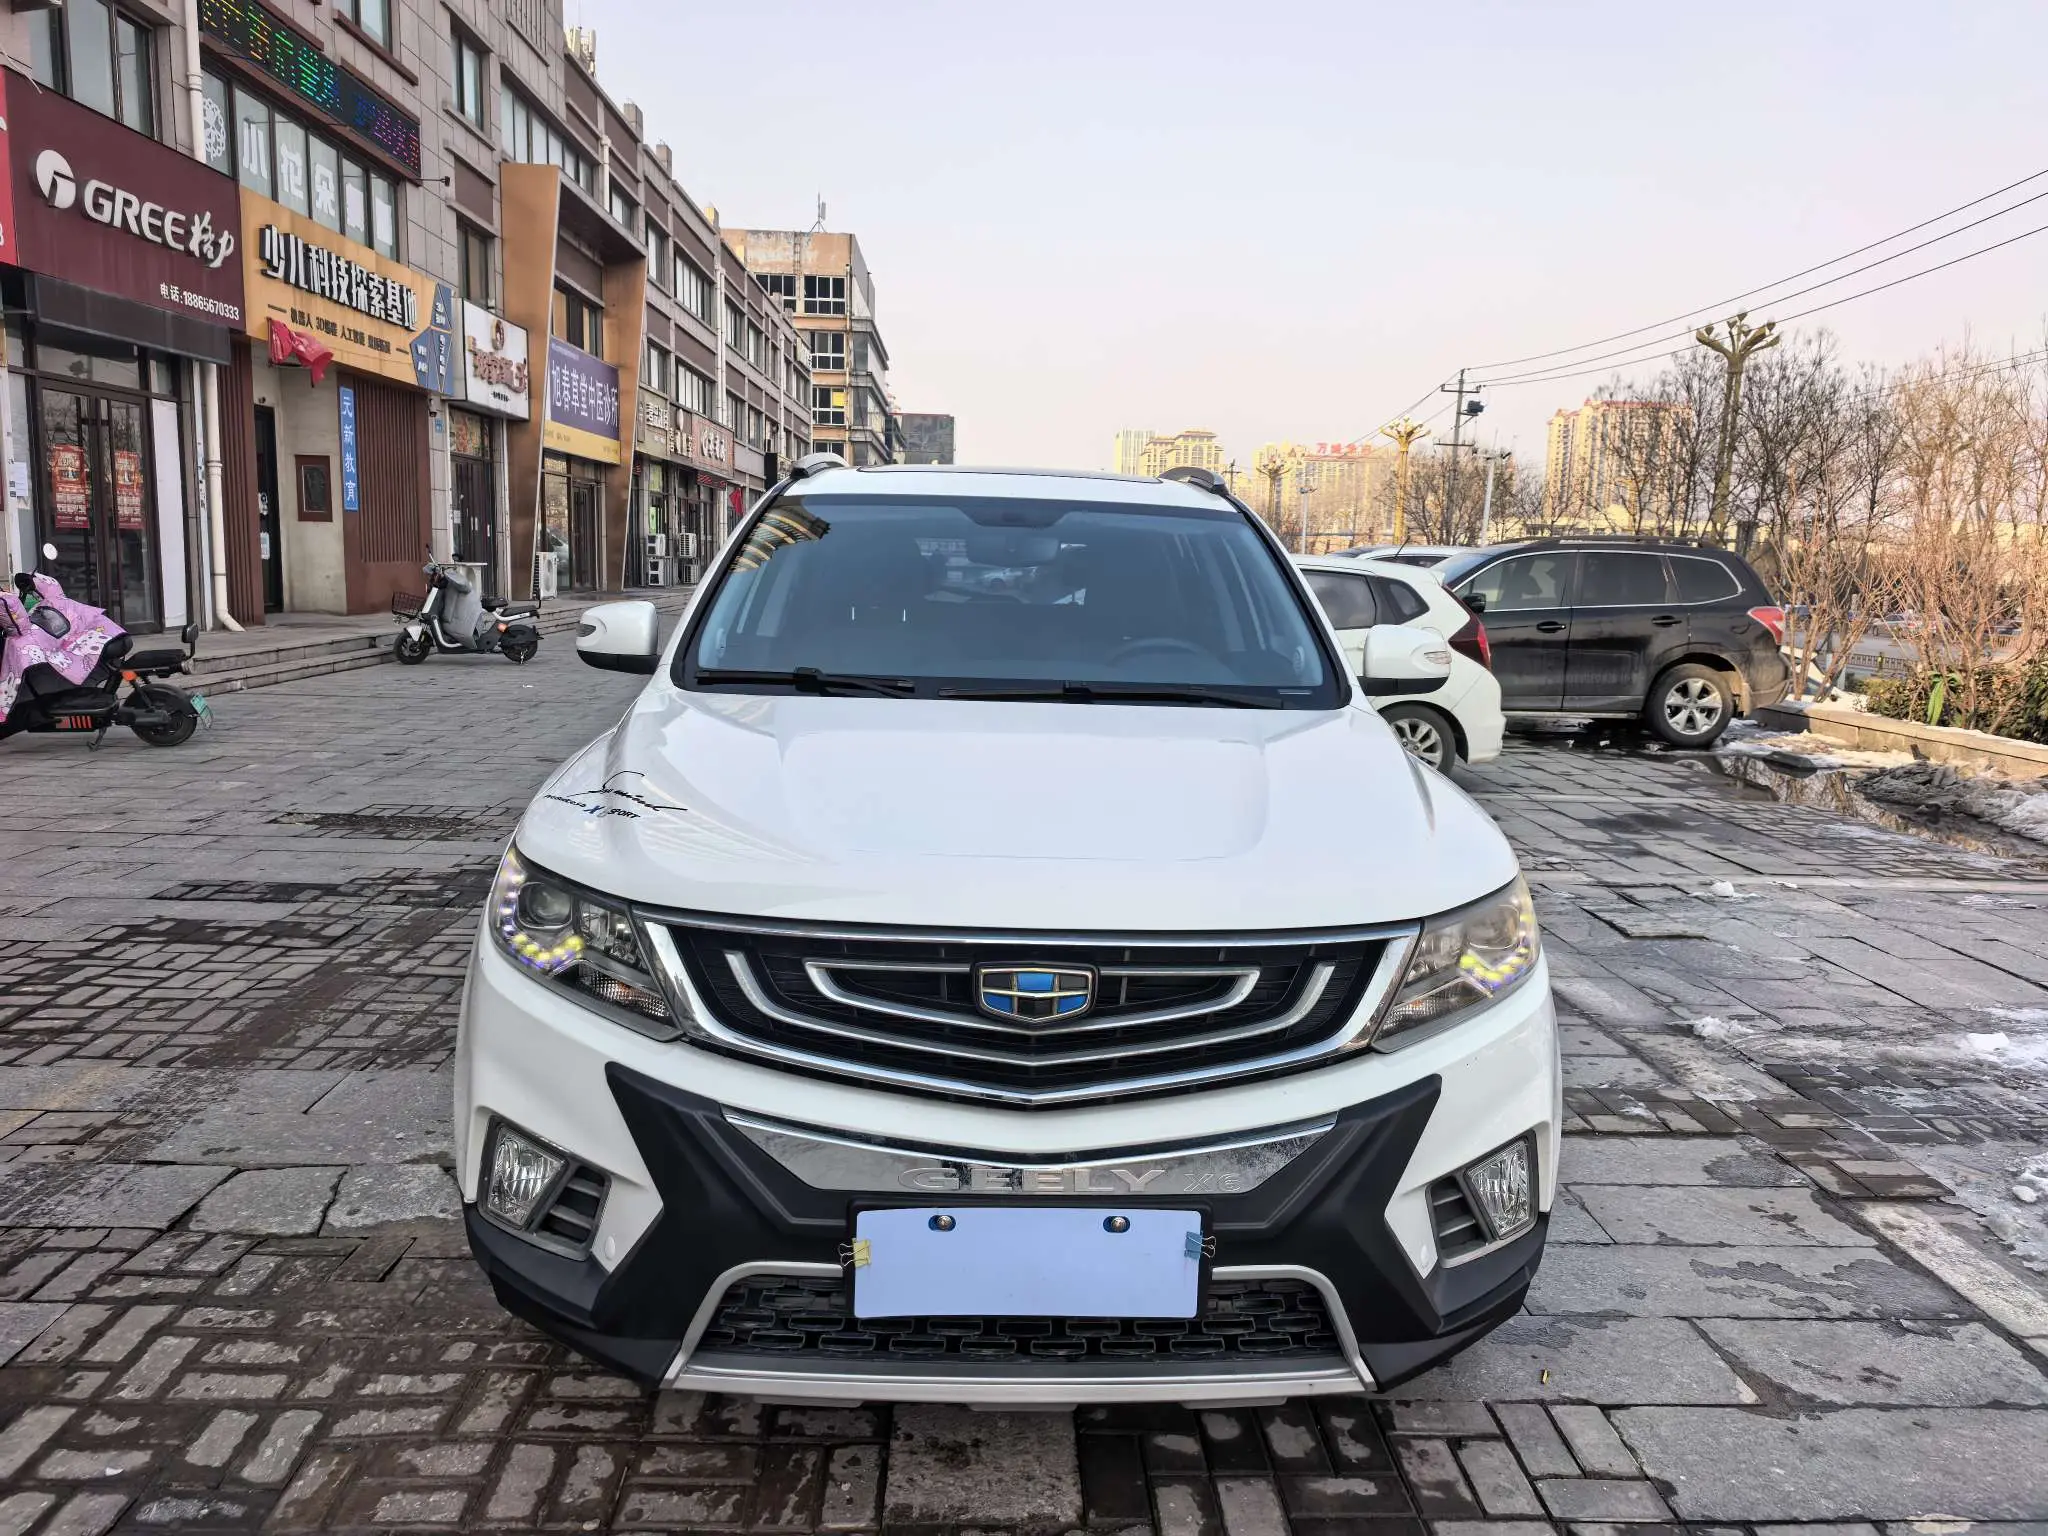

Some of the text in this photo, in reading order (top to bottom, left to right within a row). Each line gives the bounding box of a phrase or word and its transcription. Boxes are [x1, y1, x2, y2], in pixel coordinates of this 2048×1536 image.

[84, 179, 187, 252] GREE
[262, 225, 418, 331] 少儿科技探索基地
[342, 396, 356, 502] 元新教育
[608, 808, 641, 819] SPORT
[898, 1166, 1243, 1192] GEELY X6
